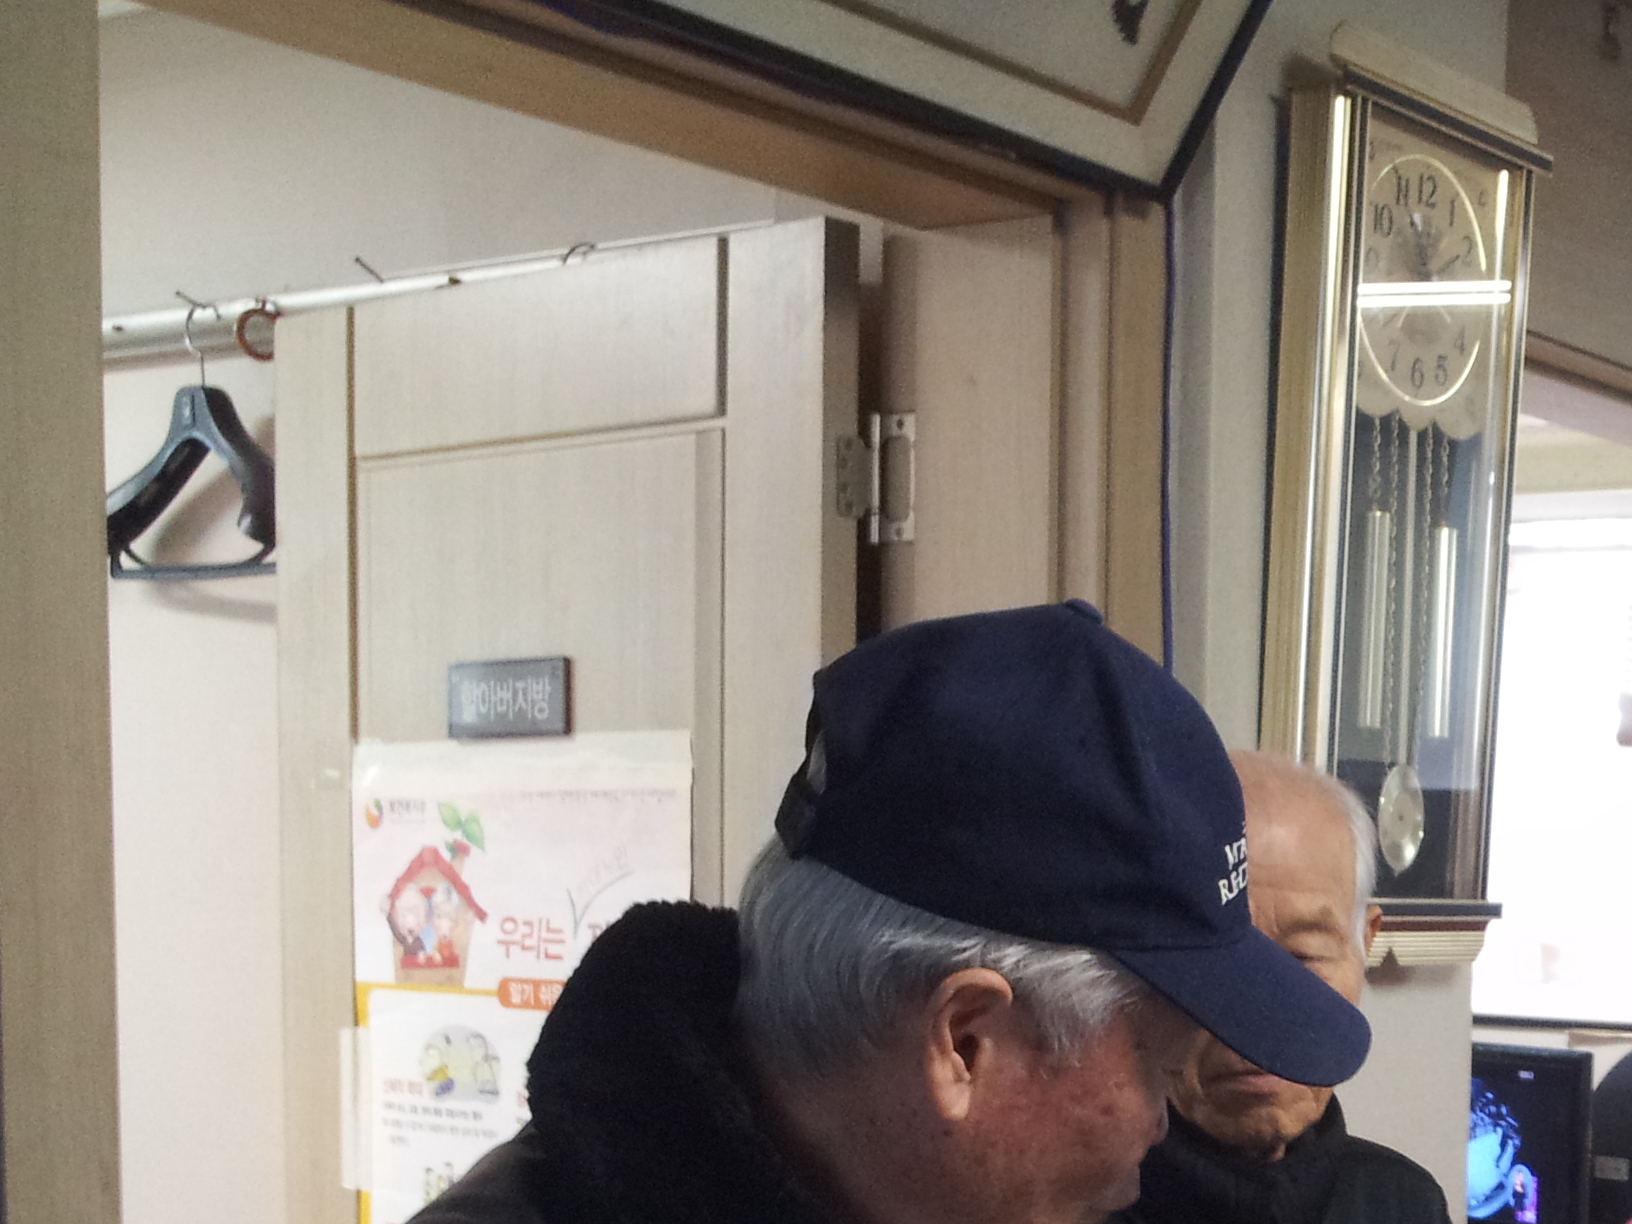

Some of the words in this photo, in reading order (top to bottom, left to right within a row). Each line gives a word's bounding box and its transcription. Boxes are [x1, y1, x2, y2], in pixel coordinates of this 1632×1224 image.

[1418, 173, 1437, 209] 12
[1373, 203, 1393, 237] 10
[1411, 357, 1424, 389] 6
[1435, 354, 1448, 387] 5
[461, 676, 551, 721] 할아버지방
[497, 916, 566, 961] 우리는
